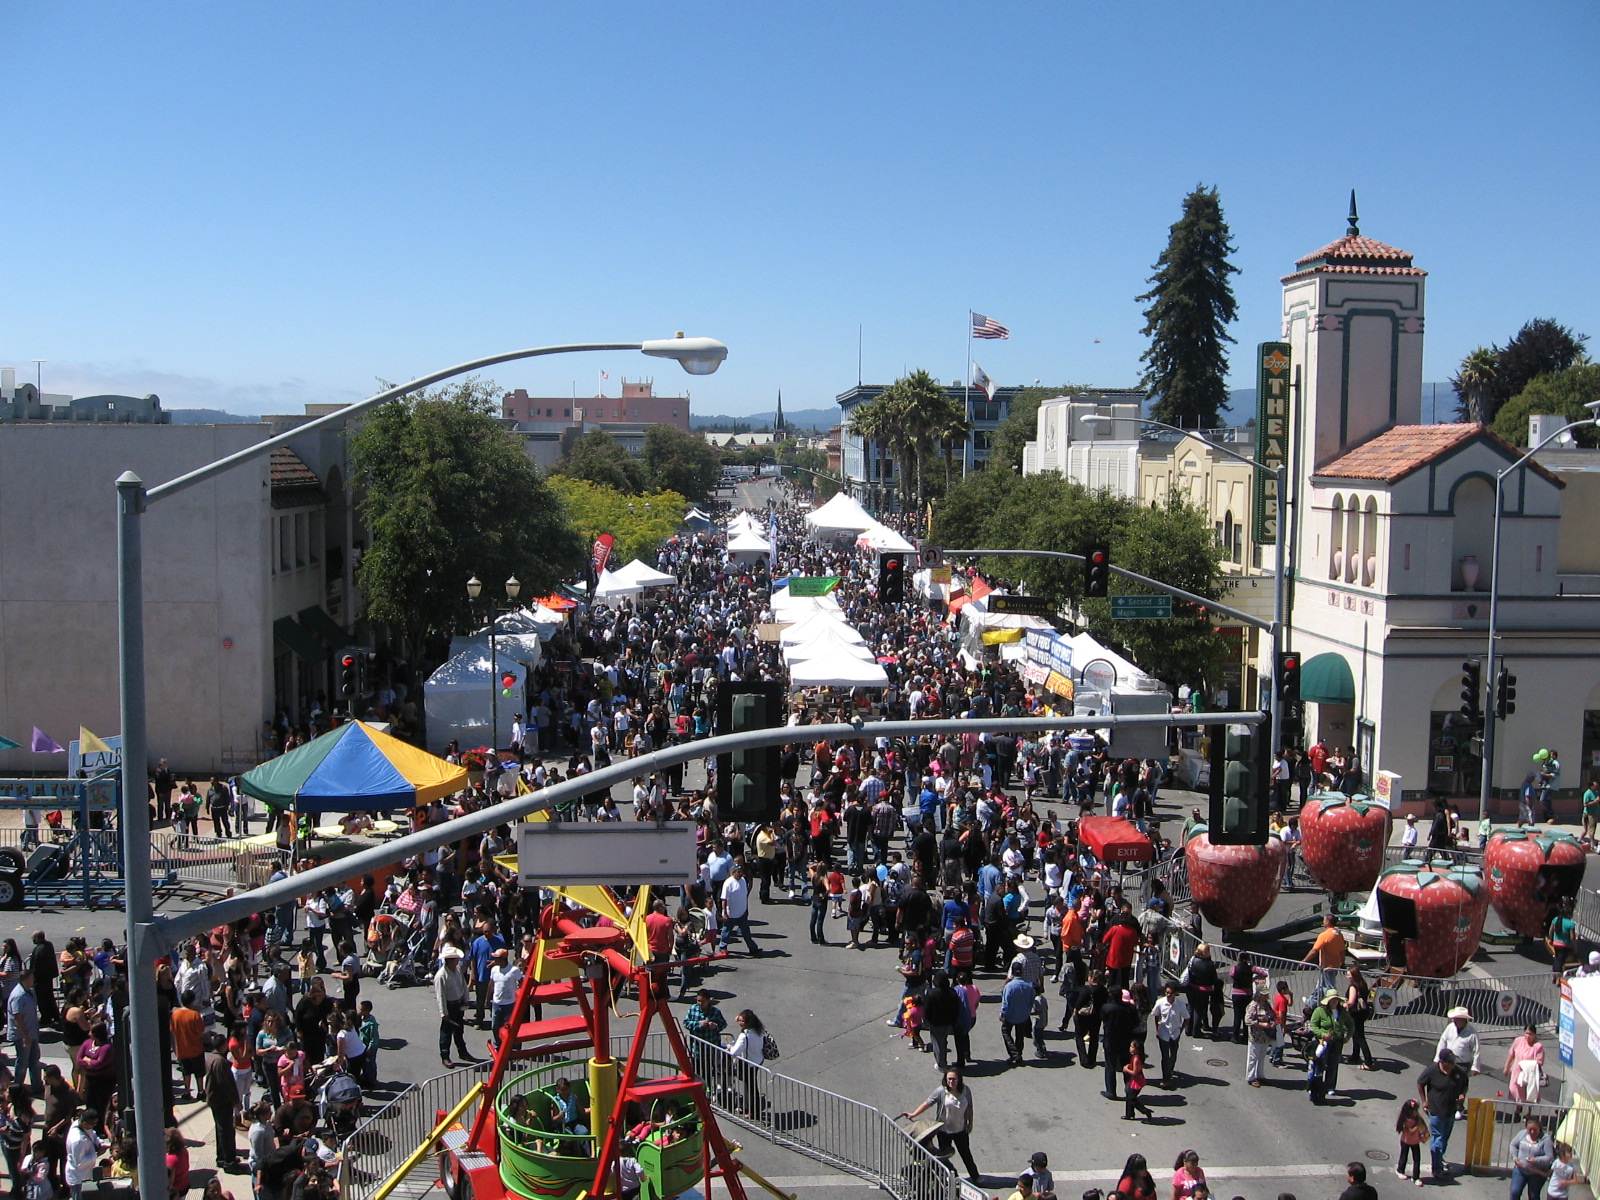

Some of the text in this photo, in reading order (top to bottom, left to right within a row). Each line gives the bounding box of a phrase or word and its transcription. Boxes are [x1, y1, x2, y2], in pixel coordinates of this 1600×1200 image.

[1263, 355, 1290, 369] Fox
[1264, 377, 1286, 538] THEATRES
[1224, 580, 1240, 588] THE
[1128, 598, 1152, 606] Second
[1117, 609, 1137, 617] Maple
[1, 783, 77, 797] TRAIN
[1117, 848, 1139, 857] EXIT
[963, 1187, 979, 1199] EXIT
